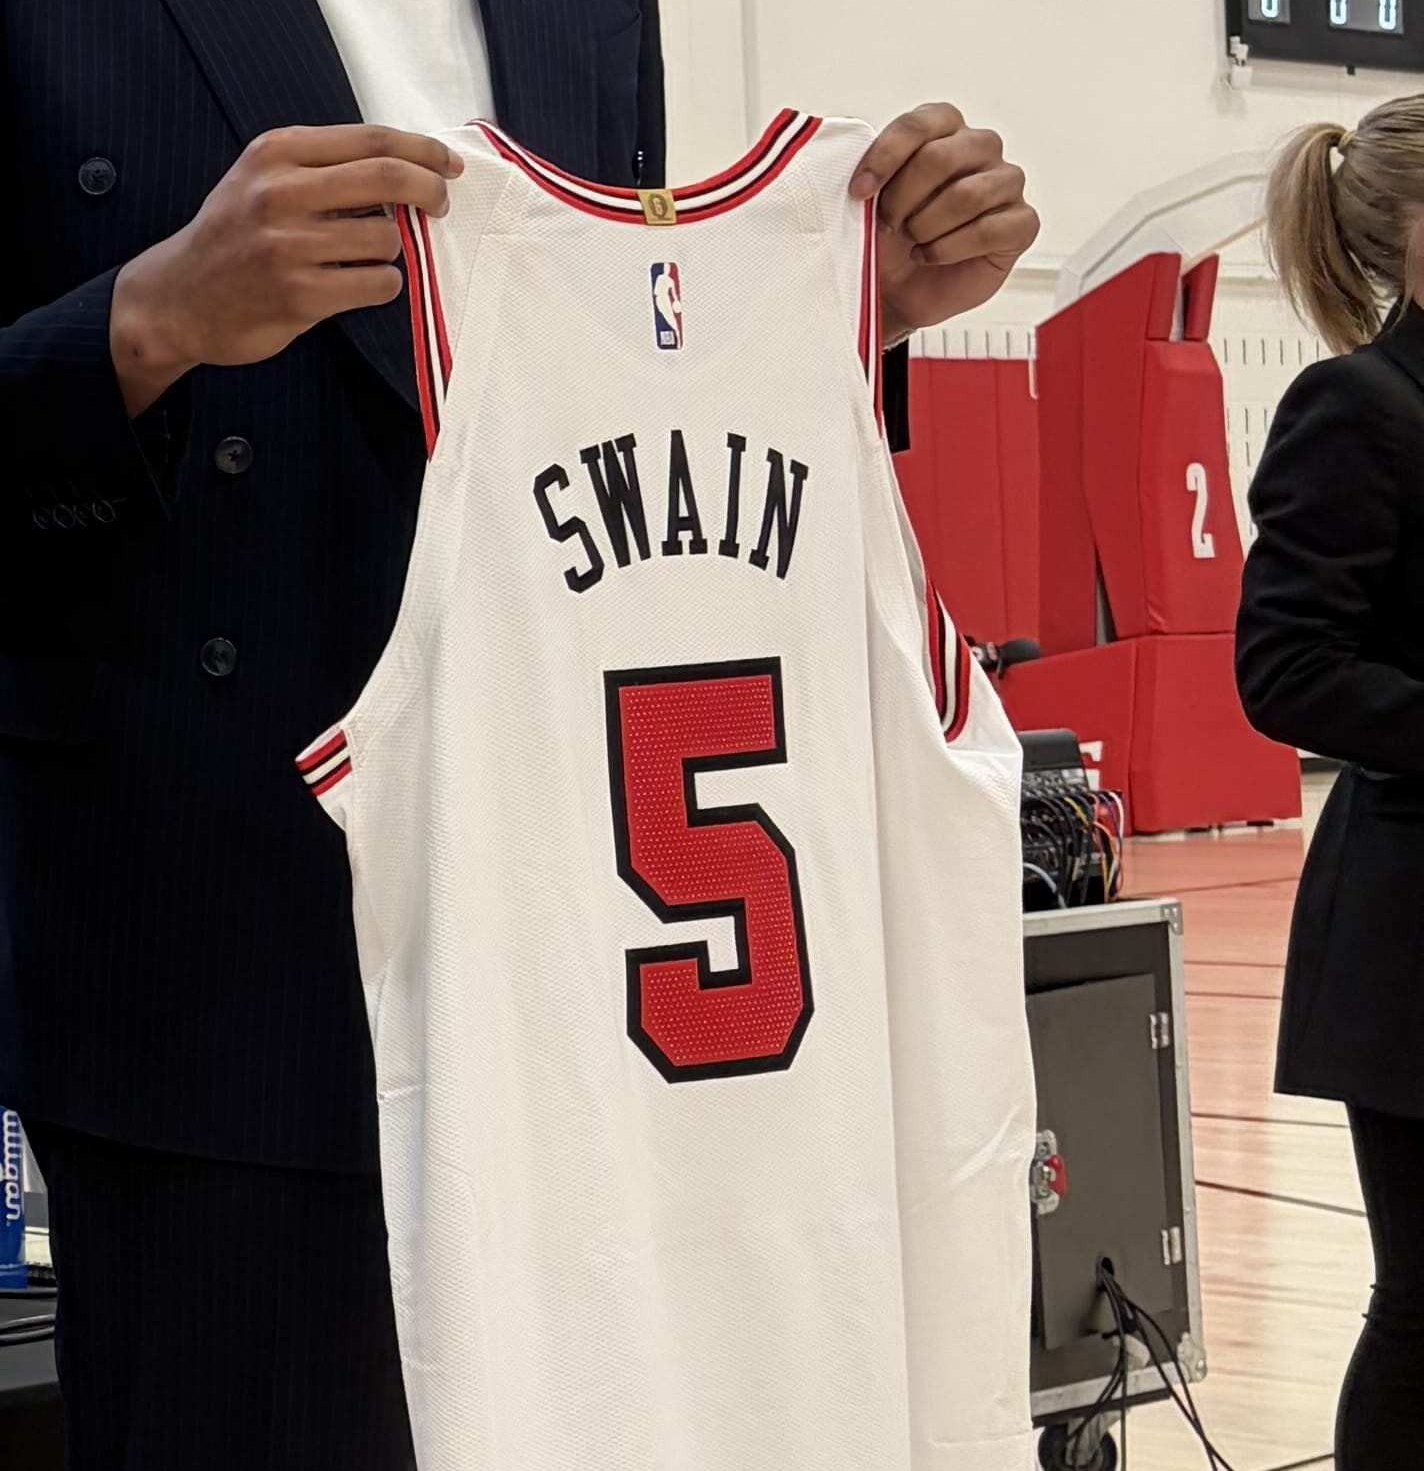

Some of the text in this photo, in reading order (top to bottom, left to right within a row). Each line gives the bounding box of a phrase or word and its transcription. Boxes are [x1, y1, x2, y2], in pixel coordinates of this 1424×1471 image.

[533, 429, 809, 593] SWAIN
[1186, 462, 1216, 558] 2
[603, 656, 815, 1084] 5
